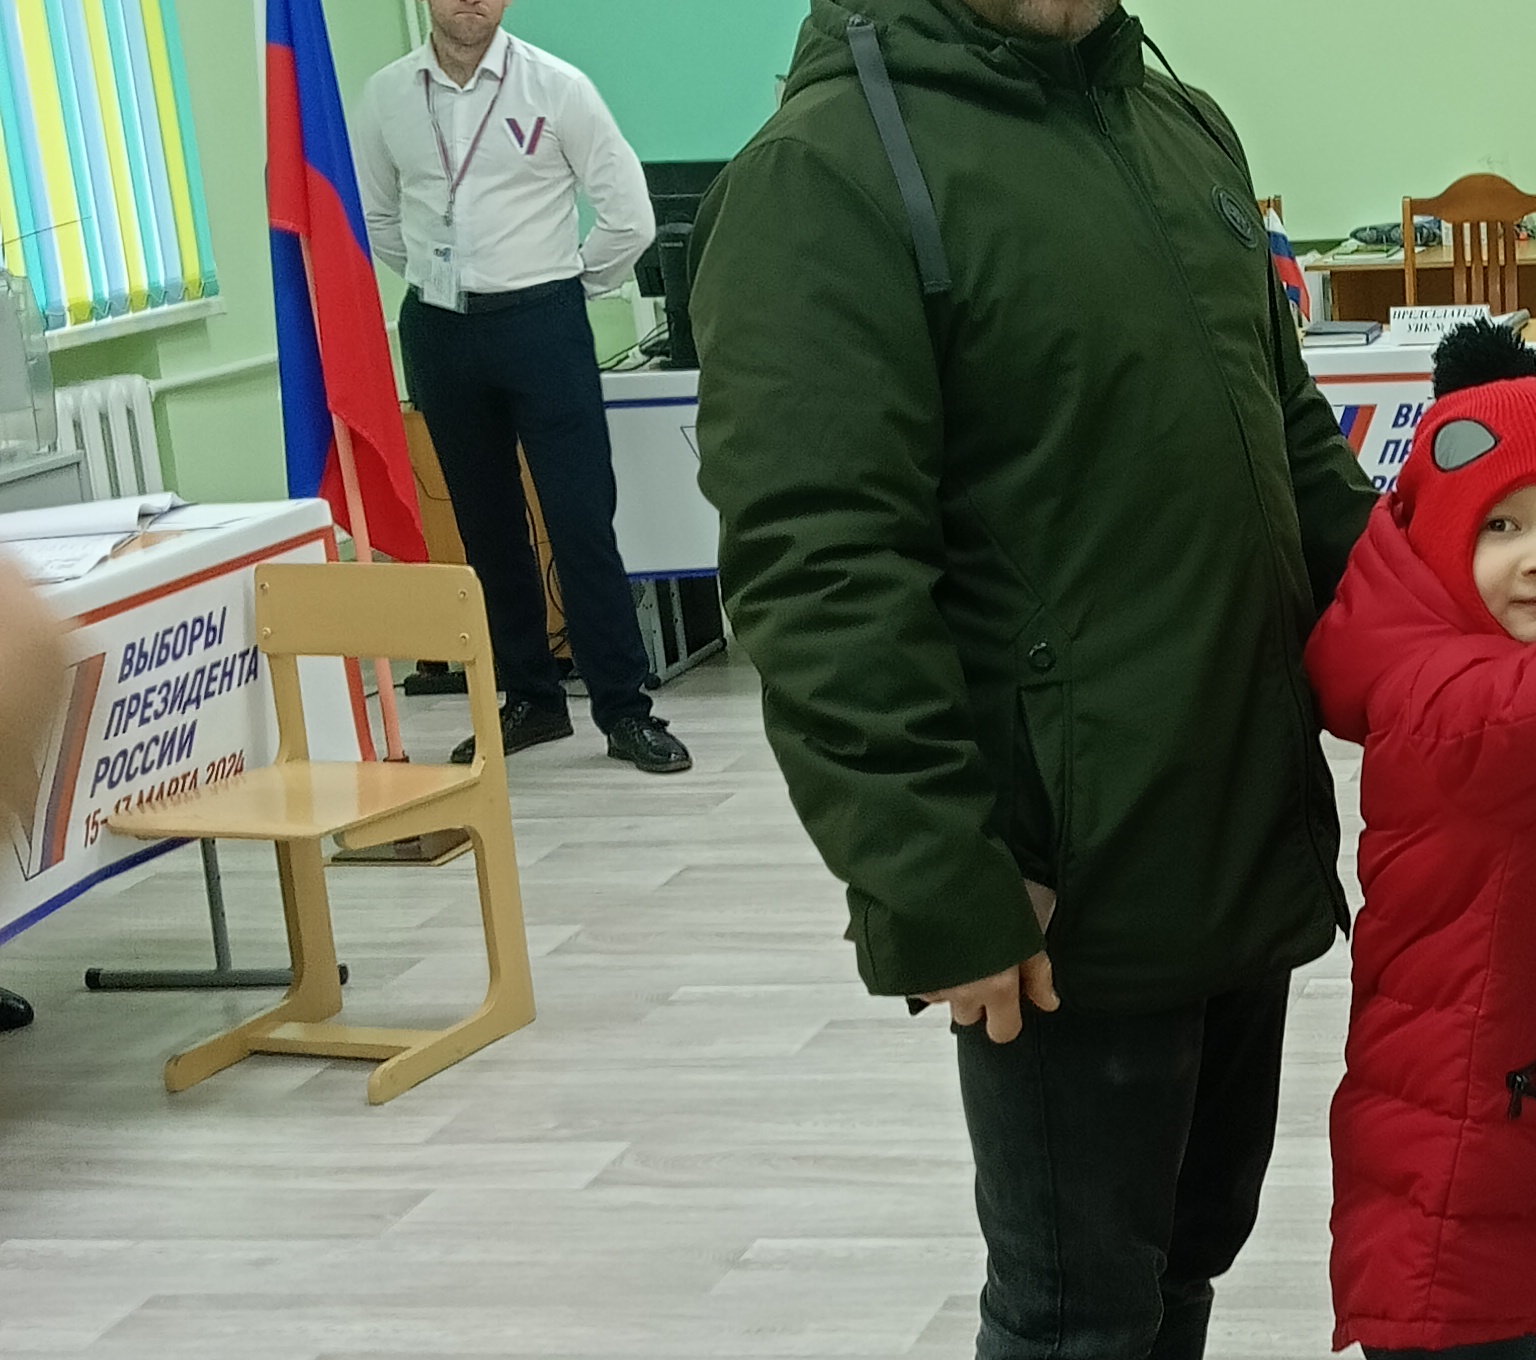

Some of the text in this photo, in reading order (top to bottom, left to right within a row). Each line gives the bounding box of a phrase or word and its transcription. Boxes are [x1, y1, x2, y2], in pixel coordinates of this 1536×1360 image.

[118, 606, 228, 684] ВЫБОРЫ
[103, 644, 259, 741] ПРЕЗИДЕНТА
[90, 719, 199, 799] РОССИИ
